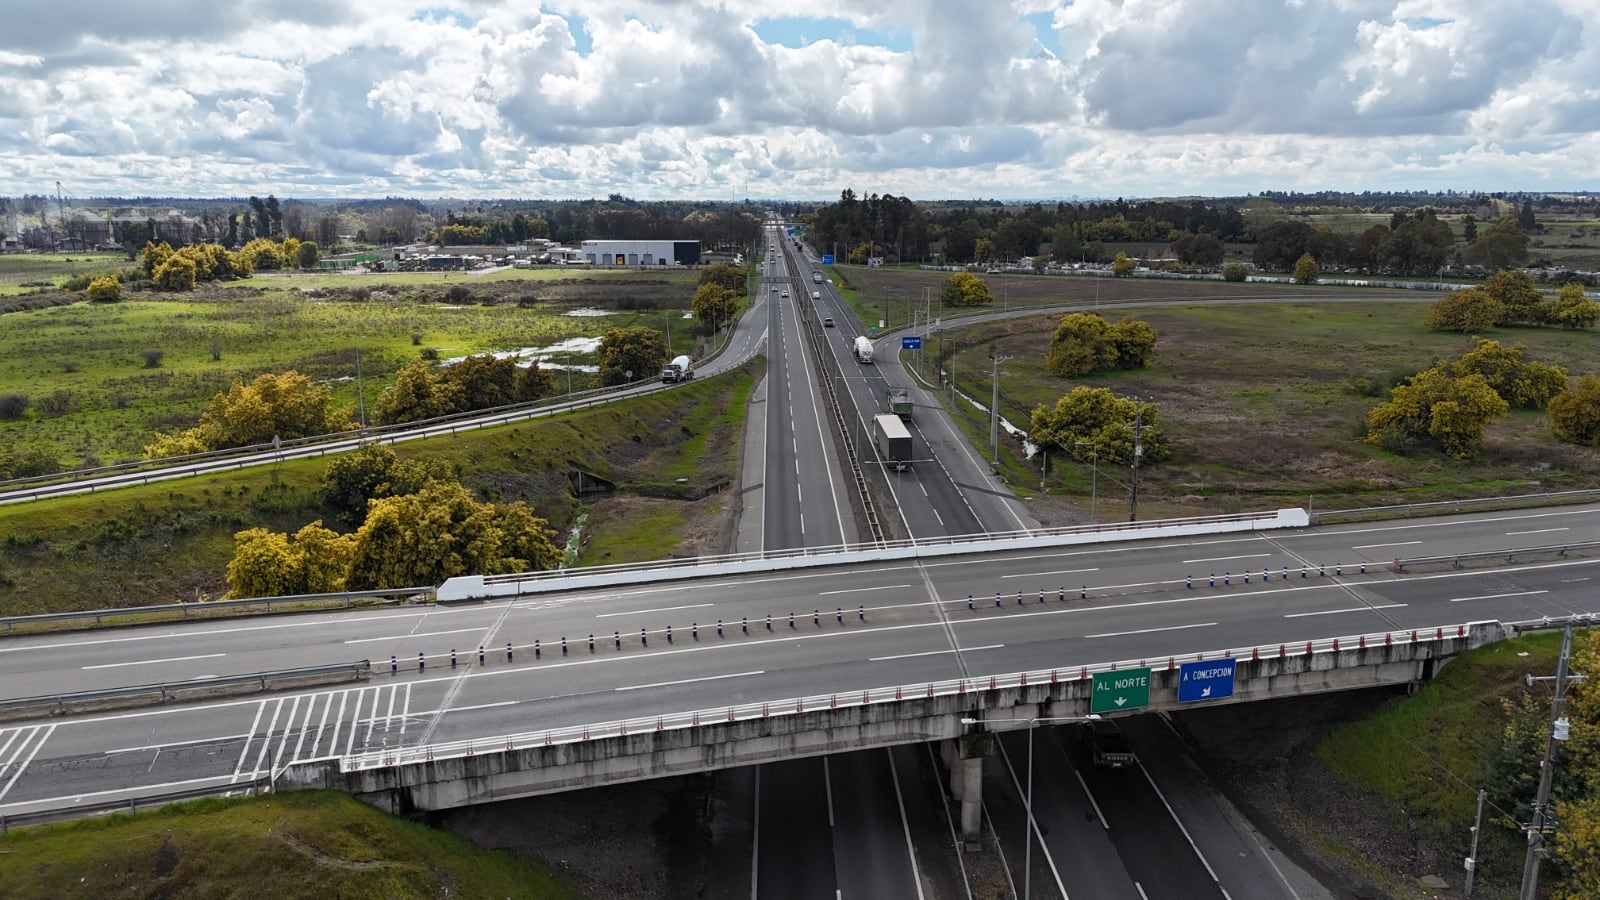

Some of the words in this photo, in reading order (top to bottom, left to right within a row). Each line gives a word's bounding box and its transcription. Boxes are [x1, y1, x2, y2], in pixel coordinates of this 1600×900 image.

[1183, 672, 1188, 682] A
[1192, 668, 1232, 681] CONCEPCION
[1096, 682, 1110, 692] AL
[1114, 676, 1147, 689] NORTE
